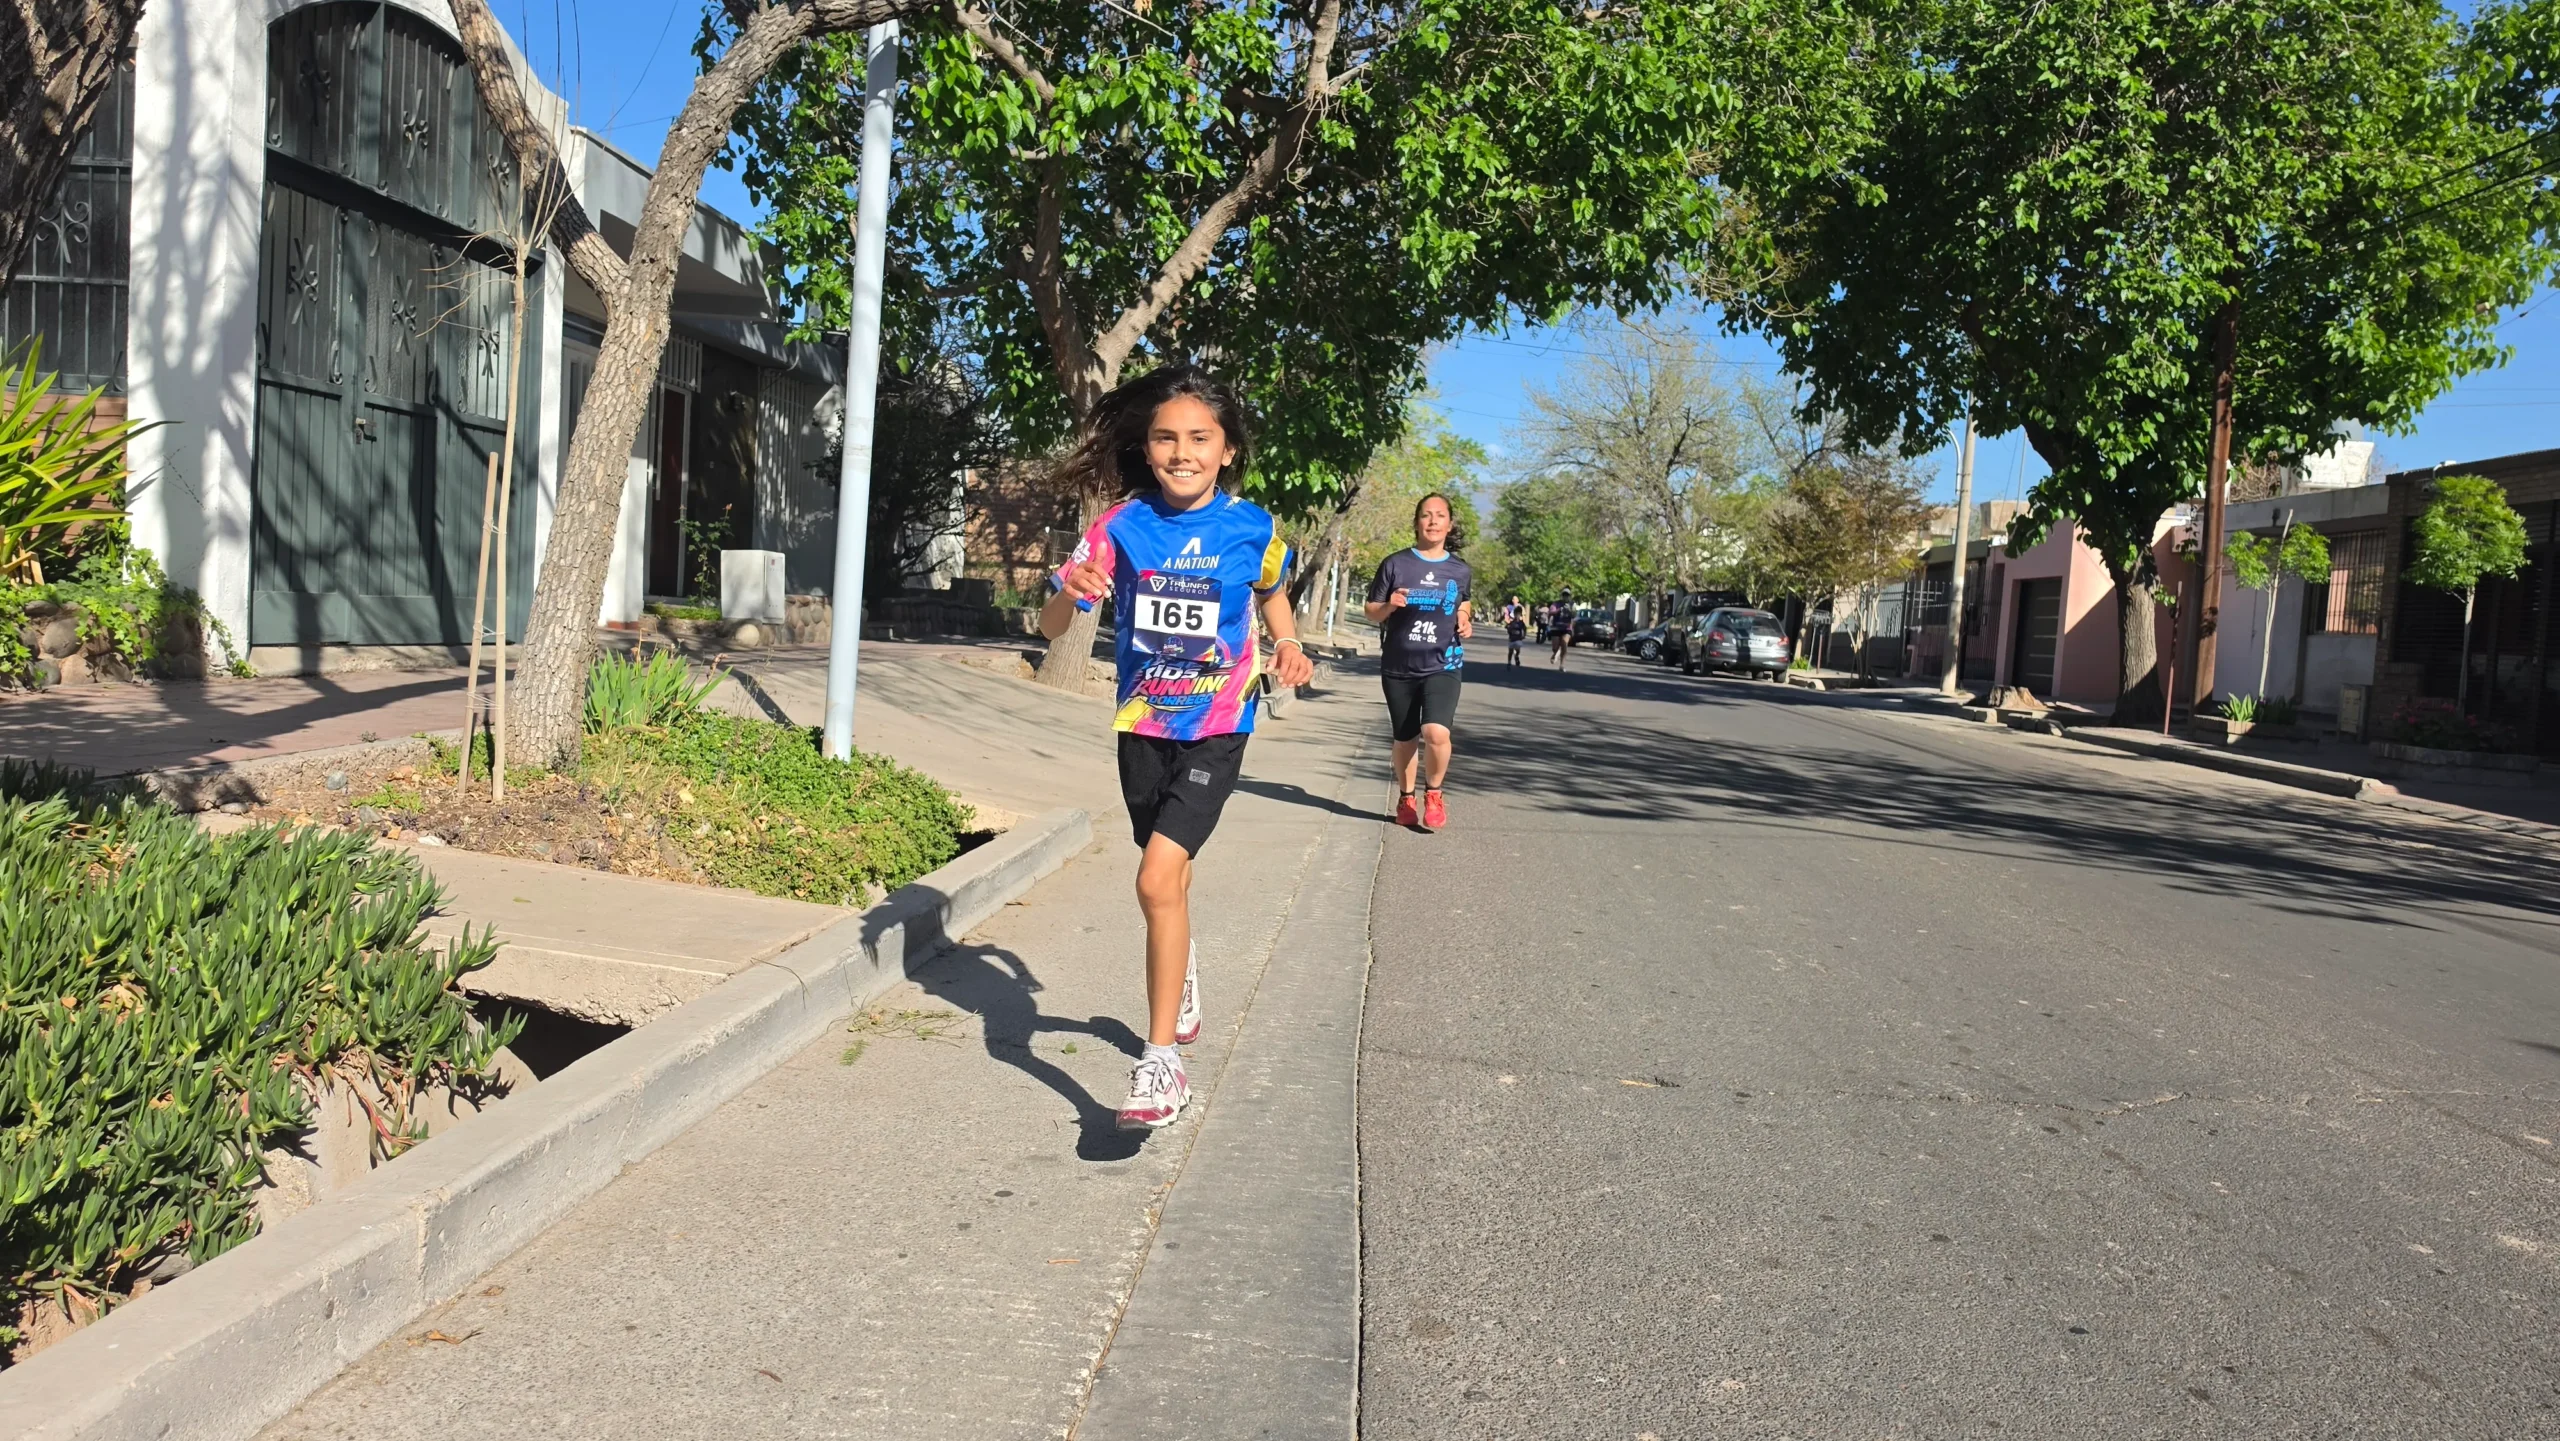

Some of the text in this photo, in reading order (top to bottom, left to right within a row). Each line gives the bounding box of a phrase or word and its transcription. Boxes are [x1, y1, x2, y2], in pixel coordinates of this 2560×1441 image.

[1162, 554, 1220, 570] A NATION
[1169, 586, 1208, 595] SEGUROS
[1151, 600, 1203, 631] 165
[1148, 693, 1215, 706] DORREGO
